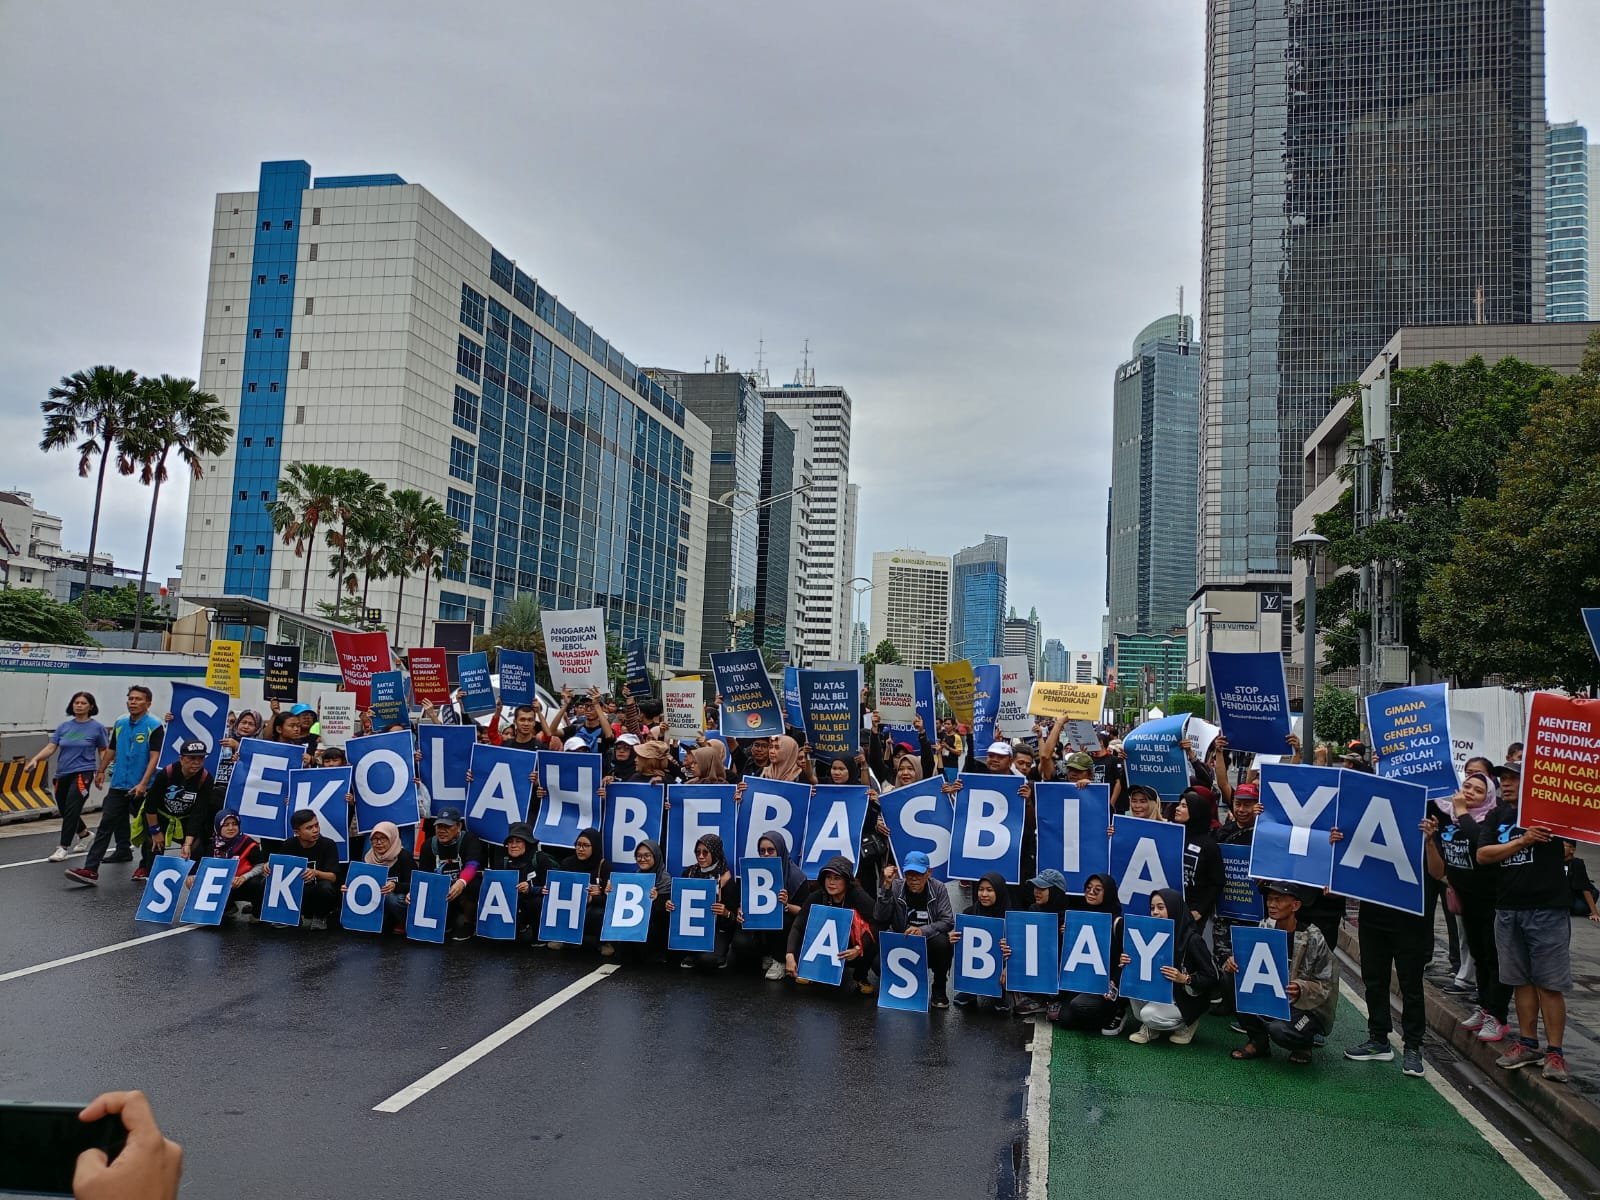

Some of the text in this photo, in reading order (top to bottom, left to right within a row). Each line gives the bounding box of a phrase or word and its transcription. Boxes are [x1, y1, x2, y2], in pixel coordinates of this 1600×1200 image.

[1126, 360, 1140, 378] BCA
[551, 626, 596, 635] ANGGARAN
[551, 634, 597, 642] PENDIDIKAN
[562, 642, 586, 650] JEBOL,
[342, 654, 377, 662] TIPU-TIPU
[718, 662, 758, 674] TRANSAKSI
[731, 691, 762, 702] JANGAN
[736, 682, 761, 692] PASAR
[736, 700, 773, 712] SEKOLAH
[810, 702, 848, 711] JABATAN,
[1038, 689, 1098, 699] KOMERSIALISASI
[1043, 695, 1089, 704] PENDIDIKAN!
[1220, 694, 1280, 703] LIBERALISASI
[1222, 701, 1280, 711] PENDIDIKAN!
[1385, 701, 1426, 716] GIMANA
[172, 697, 218, 758] S
[820, 712, 850, 721] BAWAH
[1384, 724, 1432, 741] GENERASI
[1394, 715, 1417, 726] MAU
[1538, 716, 1591, 732] MENTERI
[816, 743, 848, 752] SEKOLAH
[1381, 742, 1408, 756] EMAS,
[1410, 735, 1440, 748] KALO
[1390, 749, 1433, 766] SEKOLAH
[1536, 745, 1600, 764] KE MANA?
[1537, 731, 1600, 748] PENDIDIKA
[239, 753, 289, 820] E
[355, 749, 409, 807] O
[431, 738, 465, 800] L
[1140, 764, 1181, 773] SEKOLAH!!
[1385, 761, 1443, 779] AJA SUSAH?
[1532, 774, 1600, 793] CARI NGGA
[1534, 760, 1565, 774] KAMI
[294, 780, 344, 842] K
[469, 762, 522, 824] A
[545, 764, 592, 829] H
[1531, 788, 1600, 810] PERNAH AD
[611, 797, 649, 864] B
[746, 792, 794, 858] B
[807, 801, 855, 864] A
[900, 796, 951, 868] S
[962, 788, 1011, 860] B
[1064, 799, 1080, 872] I
[1268, 782, 1338, 857] Y
[1340, 796, 1419, 885] A
[147, 869, 181, 914] S
[194, 868, 229, 912] E
[268, 864, 304, 912] K
[748, 868, 778, 914] B
[1117, 837, 1170, 905] A
[346, 875, 381, 915] O
[414, 882, 437, 928] L
[479, 881, 514, 924] A
[545, 881, 583, 929] H
[611, 884, 644, 928] B
[680, 889, 706, 937] E
[803, 919, 842, 967] A
[962, 927, 996, 979] B
[1025, 924, 1038, 976] I
[1064, 925, 1107, 976] A
[1127, 928, 1170, 982] Y
[887, 948, 920, 999] S
[1239, 942, 1287, 999] A
